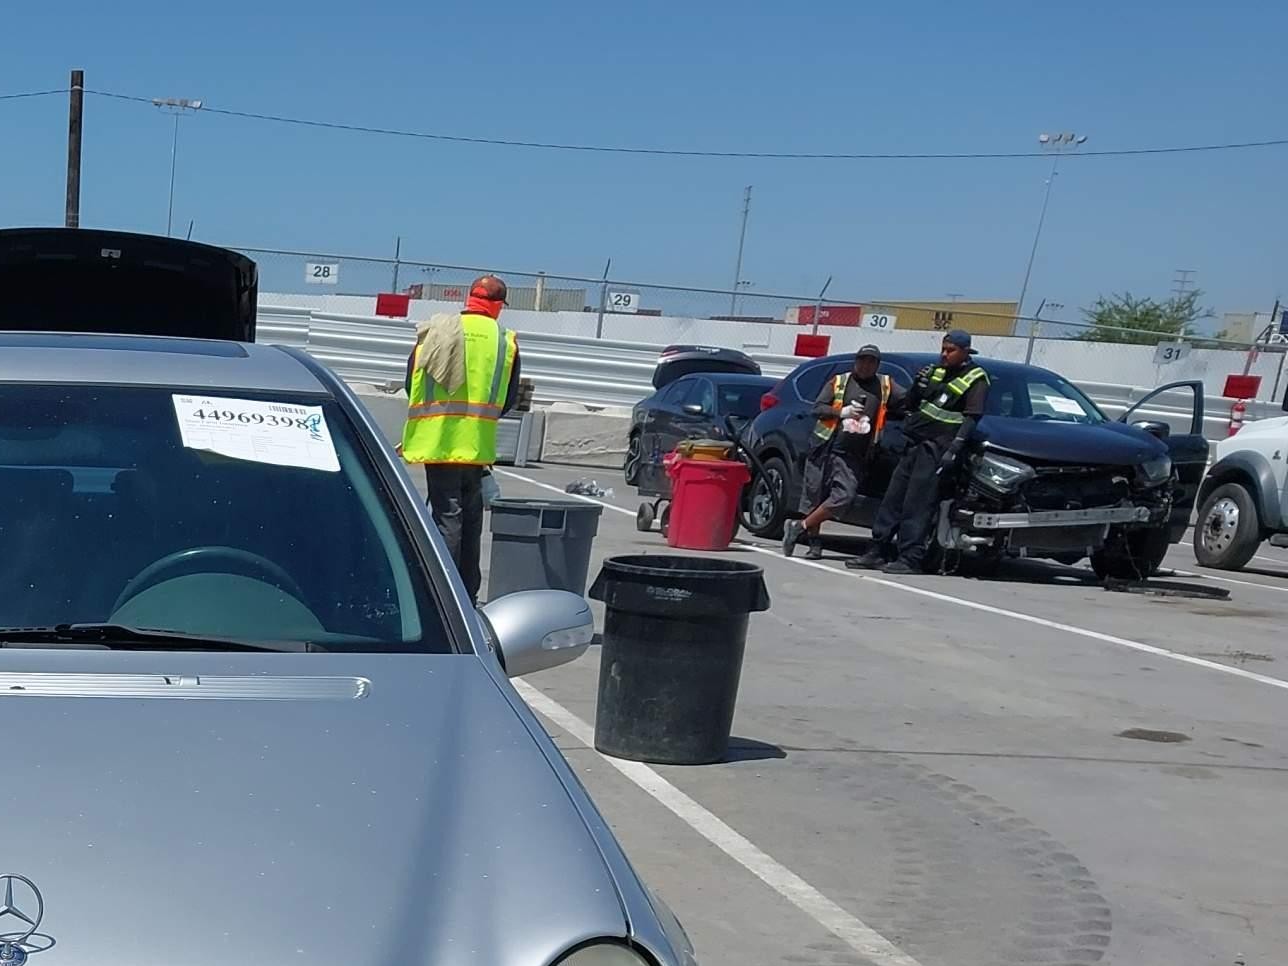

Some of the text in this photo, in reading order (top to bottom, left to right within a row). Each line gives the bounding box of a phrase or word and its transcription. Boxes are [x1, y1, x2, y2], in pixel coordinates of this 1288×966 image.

[313, 265, 331, 278] 28
[613, 294, 632, 307] 29
[869, 314, 889, 329] 30
[1163, 347, 1182, 360] 31
[192, 407, 310, 431] 44969398
